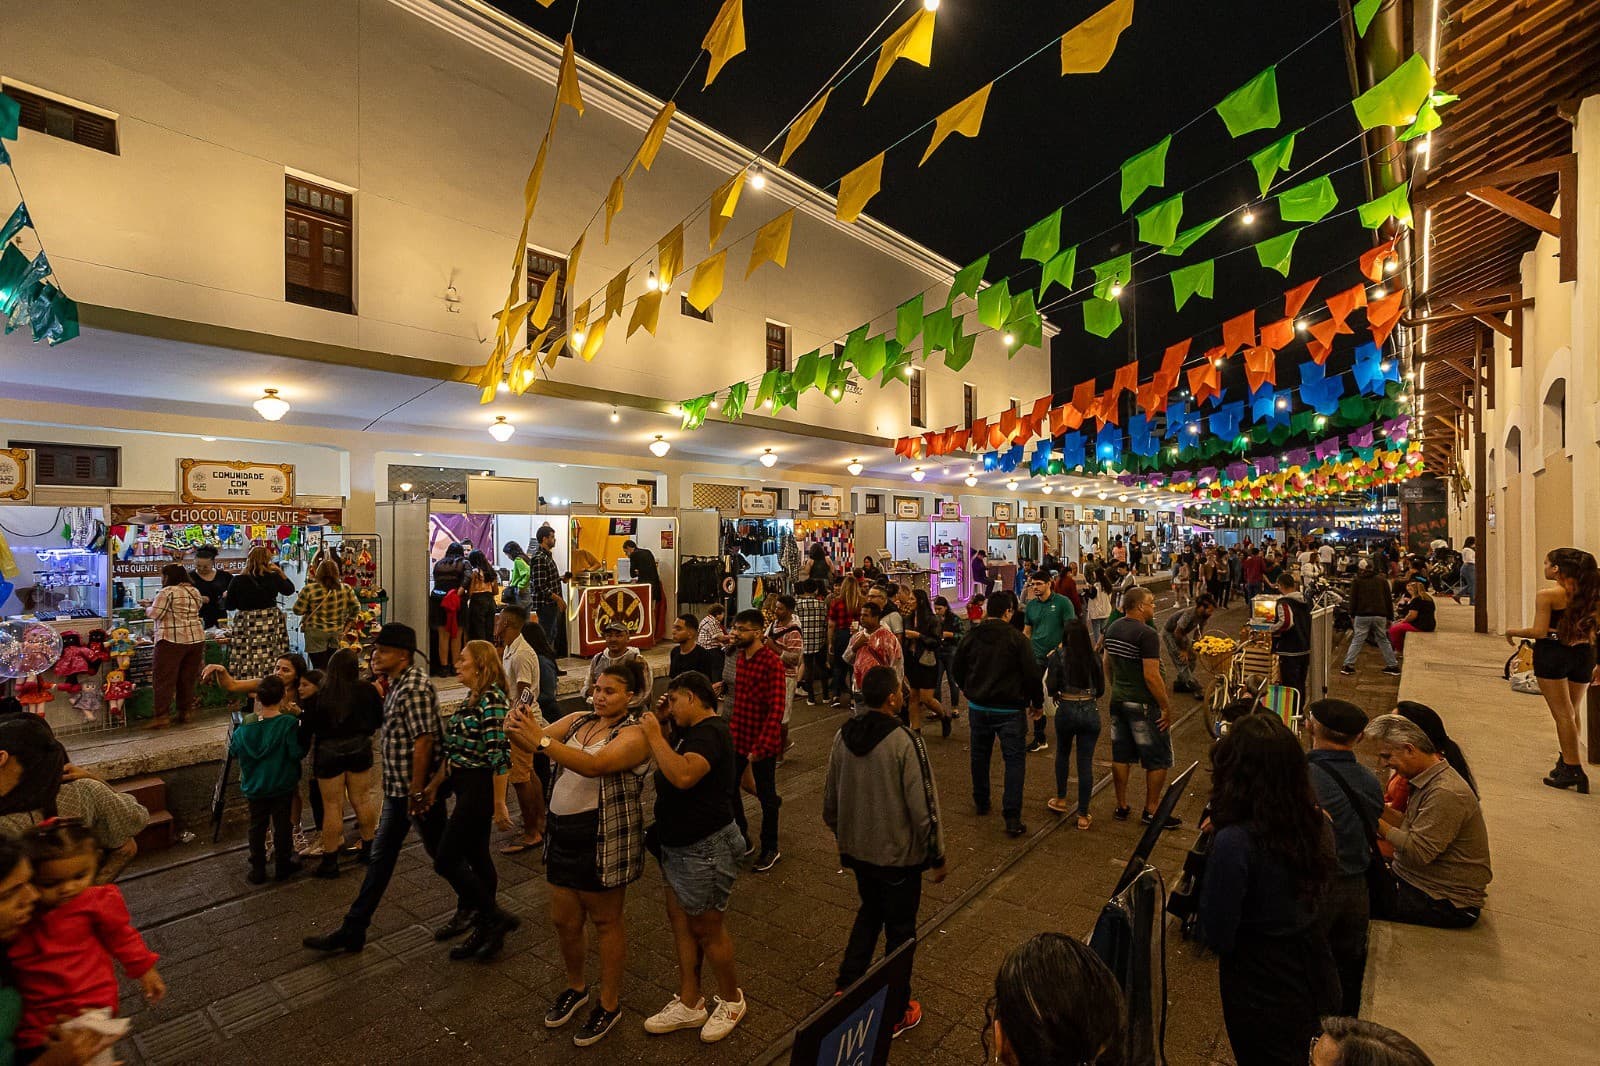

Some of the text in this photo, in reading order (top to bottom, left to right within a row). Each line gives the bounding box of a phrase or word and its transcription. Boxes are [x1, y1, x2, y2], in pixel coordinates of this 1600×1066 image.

[212, 471, 265, 481] COMUNIDADE
[230, 480, 248, 488] COM
[227, 488, 252, 496] ARTE
[170, 509, 299, 524] CHOCOLATE QUENTE
[130, 564, 158, 574] QUENTE
